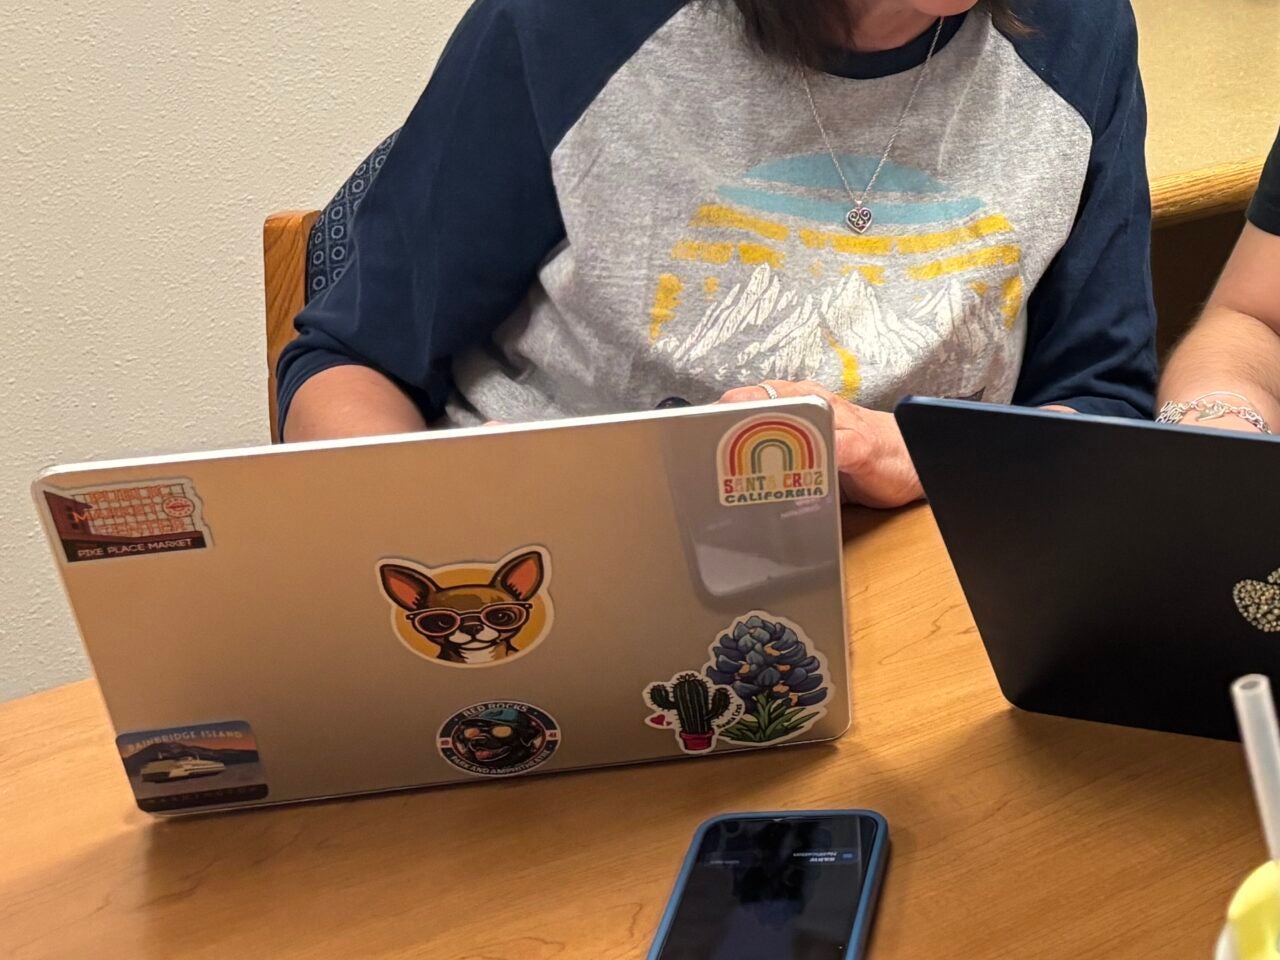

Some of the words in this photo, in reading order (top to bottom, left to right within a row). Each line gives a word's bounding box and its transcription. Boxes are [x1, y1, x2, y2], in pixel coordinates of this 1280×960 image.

[724, 475, 776, 494] SANTA
[783, 471, 823, 488] CRUZ
[725, 487, 823, 504] CALIFORNIA
[78, 549, 104, 557] PIKE
[107, 544, 144, 554] PLACE
[148, 539, 192, 549] MARKET
[462, 704, 486, 717] RED
[488, 702, 528, 712] ROCKS
